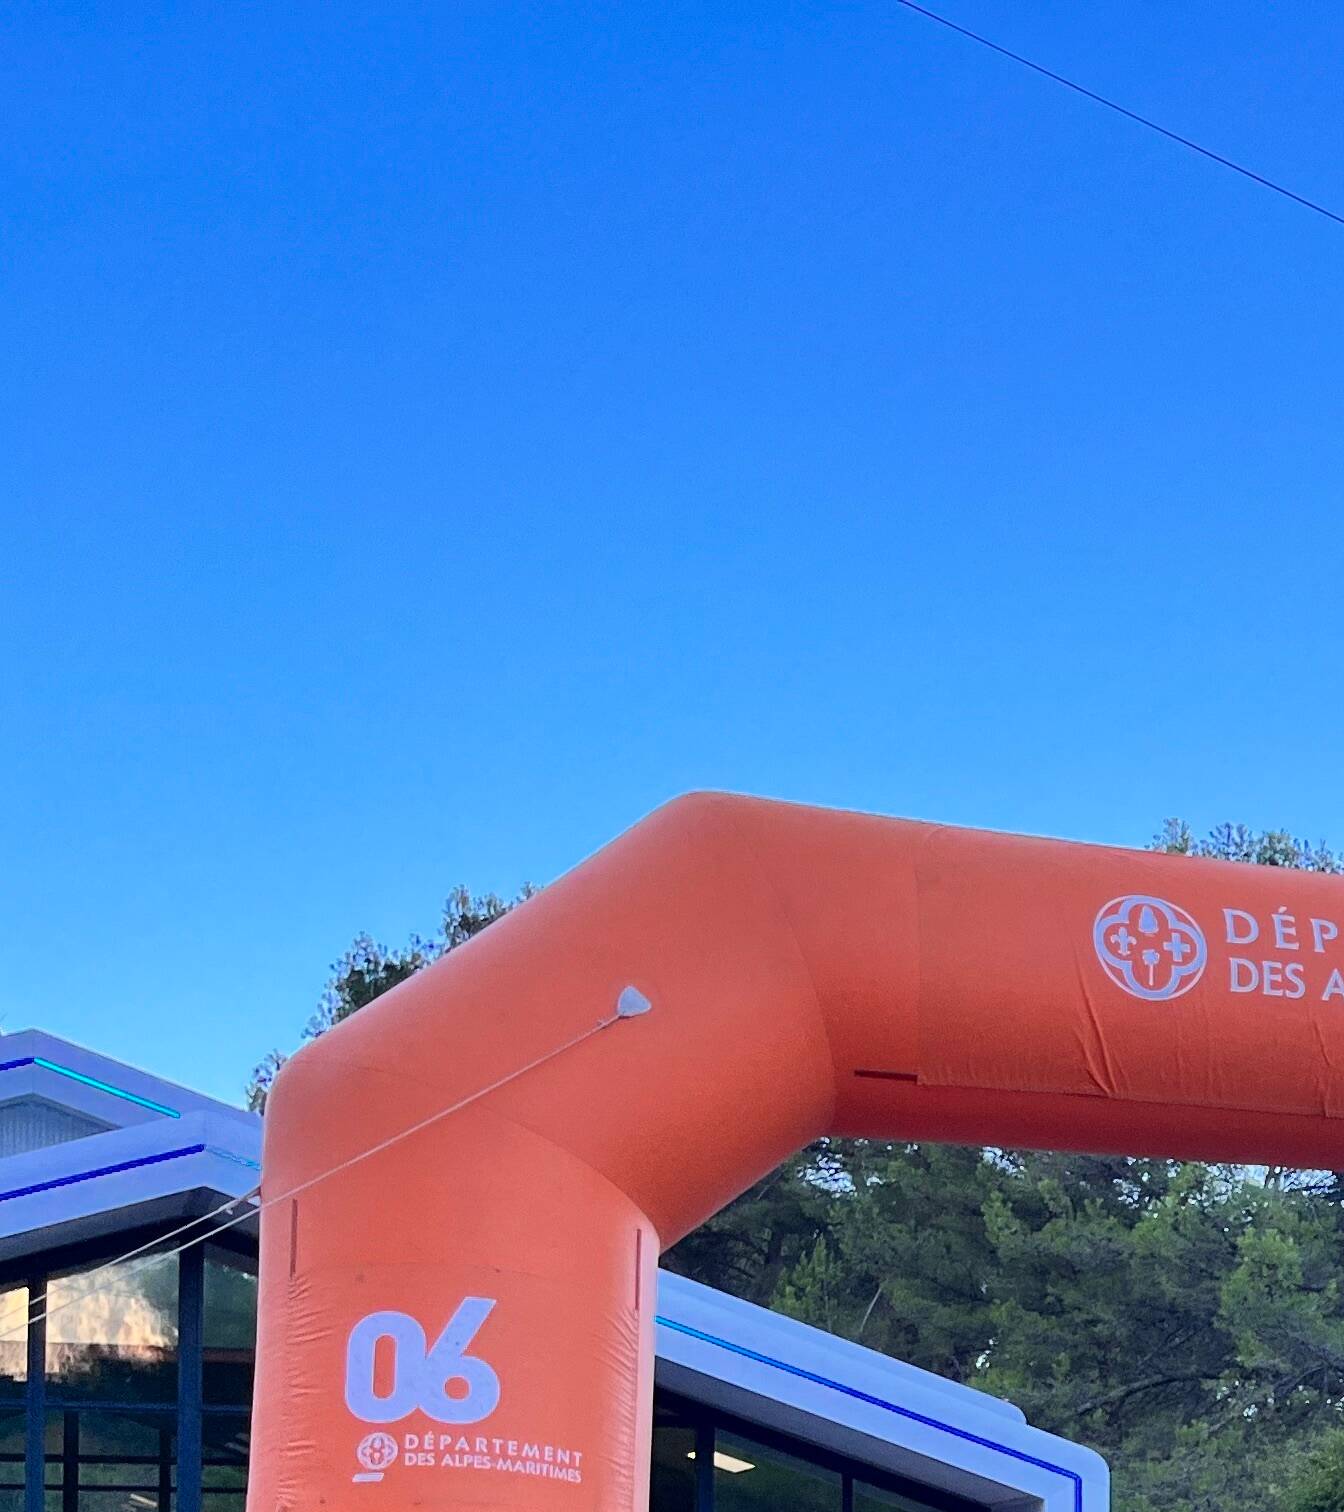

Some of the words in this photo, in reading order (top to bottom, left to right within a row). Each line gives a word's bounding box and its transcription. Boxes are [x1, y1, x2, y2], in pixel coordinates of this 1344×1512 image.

[1229, 957, 1306, 999] DES
[344, 1296, 501, 1425] 06
[404, 1431, 583, 1468] DÉPARTEMENT
[404, 1453, 436, 1467] DES
[440, 1453, 583, 1484] ALPES-MARITIMES
